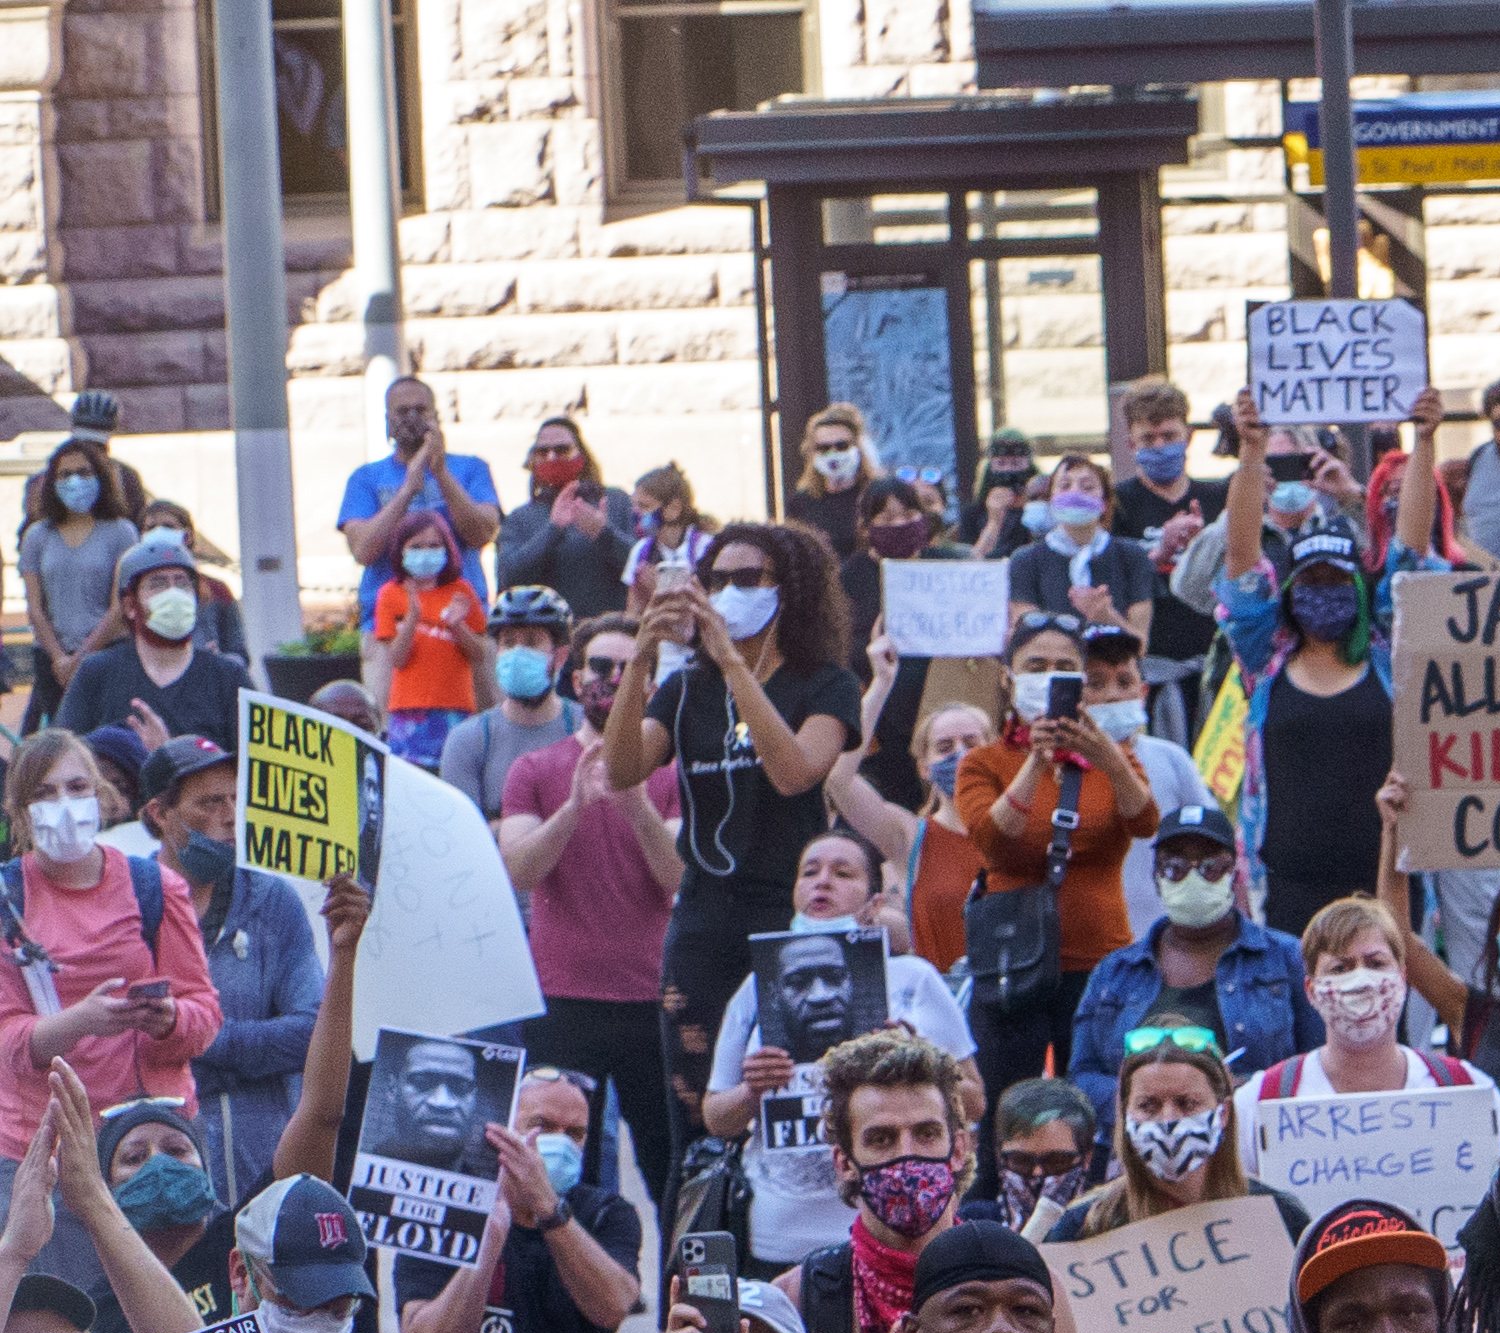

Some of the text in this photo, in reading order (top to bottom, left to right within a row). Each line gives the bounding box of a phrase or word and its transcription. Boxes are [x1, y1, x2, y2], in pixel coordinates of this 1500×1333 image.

[1353, 117, 1499, 143] GOVERNMENT
[1267, 305, 1398, 336] BLACK
[1267, 337, 1395, 372] LIVES
[1258, 374, 1411, 414] MATTER
[249, 704, 335, 767] BLACK
[250, 759, 328, 820] LIVES
[245, 821, 357, 881] MATTER
[1277, 1098, 1453, 1142] ARREST
[363, 1162, 486, 1206] JUSTICE
[1288, 1146, 1435, 1187] CHARGE
[398, 1200, 438, 1221] FOR
[359, 1210, 480, 1262] FLOYD
[1067, 1216, 1251, 1299] STICE
[1114, 1285, 1188, 1328] FOR
